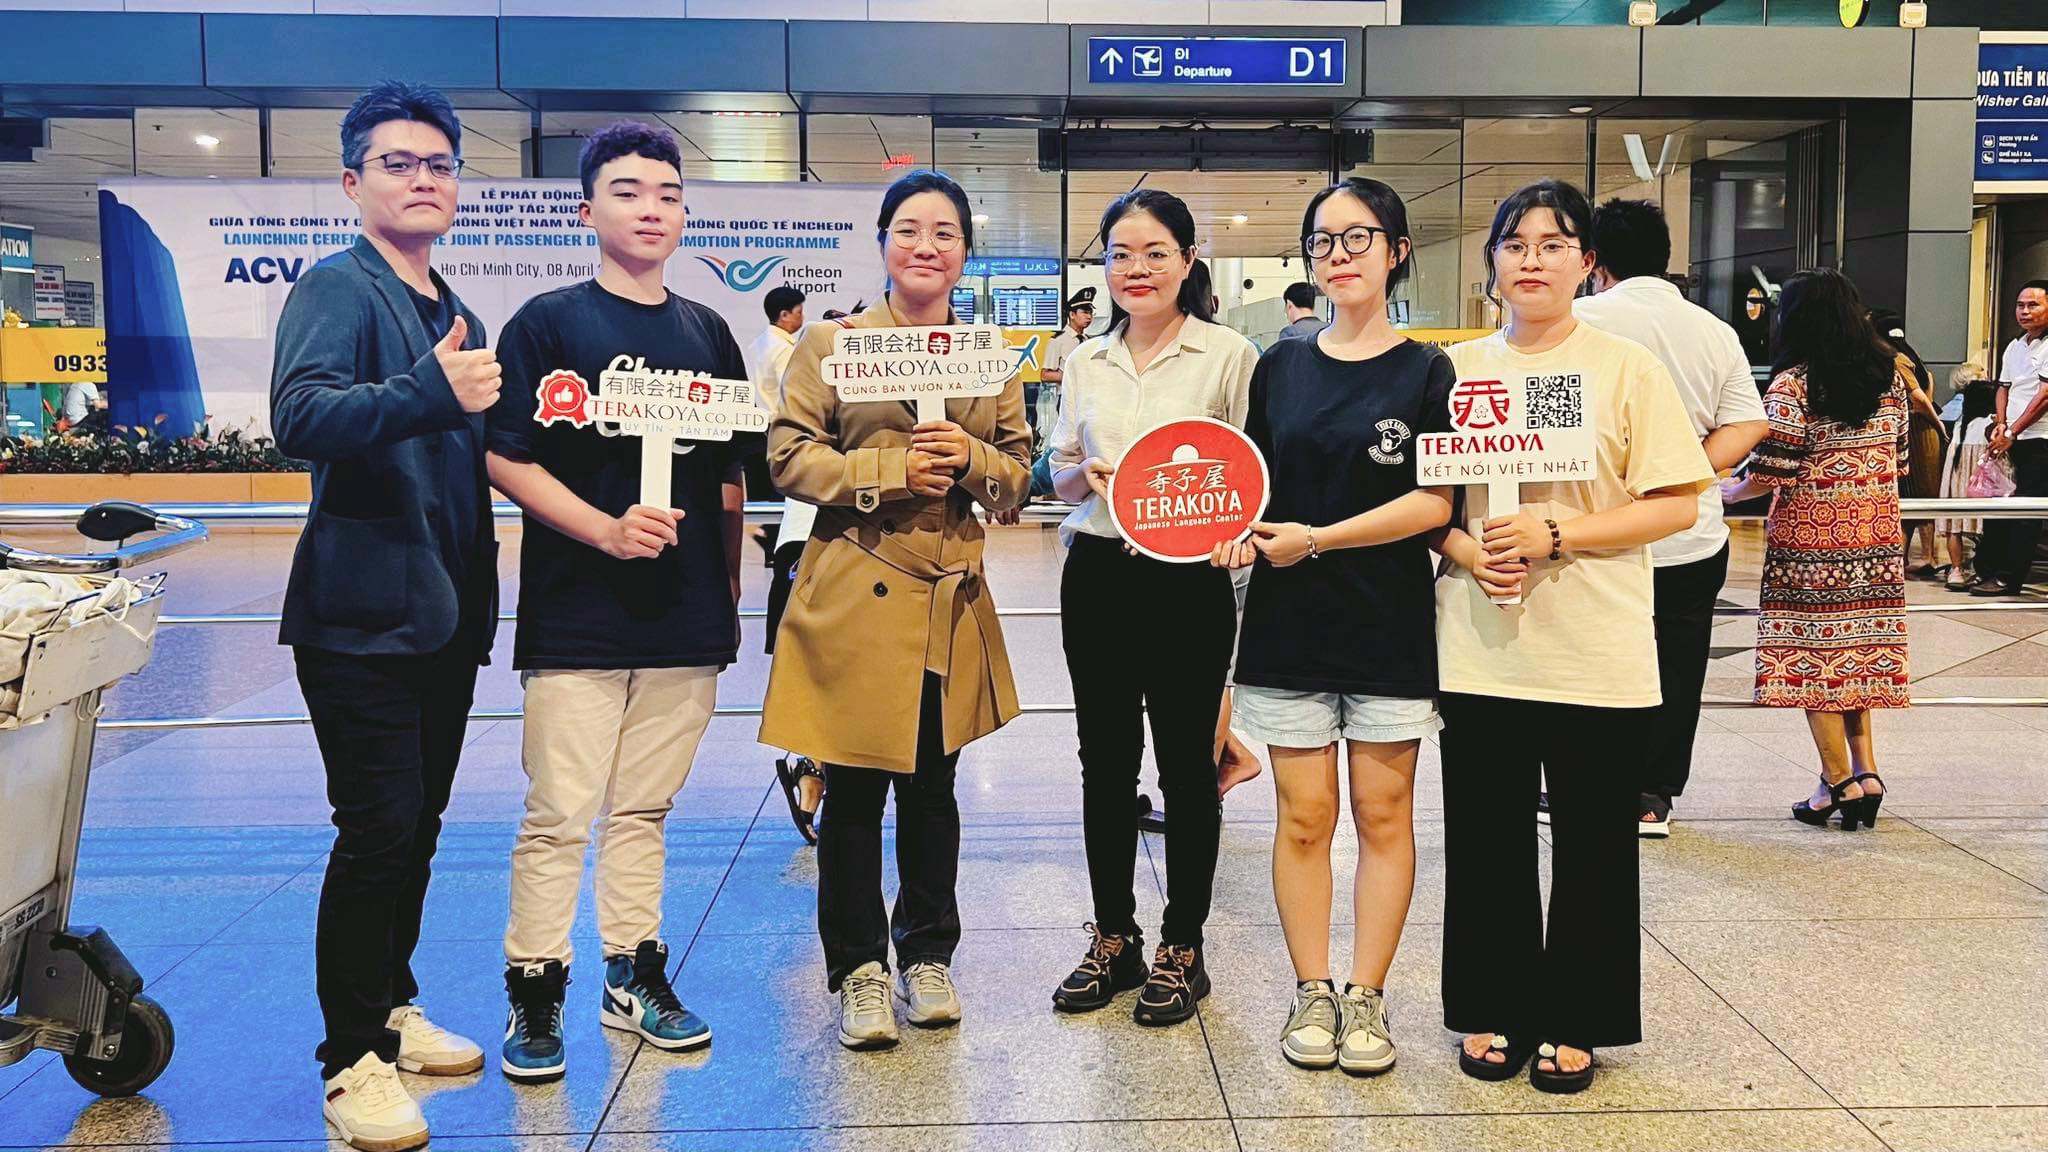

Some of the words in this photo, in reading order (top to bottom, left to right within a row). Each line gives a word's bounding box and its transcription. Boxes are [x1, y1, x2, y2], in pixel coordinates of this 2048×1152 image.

[1174, 47, 1189, 60] ĐI
[1289, 47, 1332, 77] D1
[1174, 65, 1232, 78] Departure
[1976, 69, 1999, 87] ƯA
[2003, 65, 2033, 87] TIỄN
[500, 188, 538, 200] PHÁT
[542, 189, 583, 202] ĐỘNG
[485, 203, 513, 215] HỢP
[519, 203, 545, 214] TÁC
[550, 203, 578, 214] XÚC
[209, 216, 244, 227] GIỮA
[290, 216, 329, 227] CÔNG
[334, 218, 349, 227] TY
[452, 217, 490, 227] HÔNG
[494, 217, 524, 228] VIỆT
[530, 218, 562, 228] NAM
[682, 218, 726, 229] HÔNG
[730, 218, 768, 231] QUỐC
[772, 217, 789, 230] TẾ
[792, 220, 853, 231] INCHEON
[224, 233, 308, 246] LAUNCHING
[450, 234, 490, 247] JOINT
[495, 233, 582, 247] PASSENGER
[744, 236, 840, 249] PROGRAMME
[224, 256, 304, 284] ACV
[441, 262, 457, 276] Ho
[460, 262, 479, 276] Chi
[483, 262, 512, 276] Minh
[516, 263, 543, 278] City,
[547, 263, 563, 276] 08
[567, 263, 594, 278] April
[782, 264, 842, 278] Incheon
[783, 280, 837, 296] Airport
[842, 330, 993, 355] 有限会社寺子屋
[828, 359, 943, 380] TERAKOYA
[605, 374, 750, 405] 有限会社寺子屋
[949, 381, 963, 391] XA
[592, 400, 701, 423] TERAKOYA
[624, 422, 639, 431] UY
[1422, 433, 1545, 456] TERAKOYA
[1423, 461, 1453, 478] KẾT
[1460, 461, 1491, 476] NỐI
[1499, 460, 1535, 477] VIỆT
[1543, 457, 1589, 476] NHẬT
[1145, 464, 1228, 494] 寺子屋
[1132, 489, 1243, 520] TERAKOYA
[1134, 521, 1170, 531] Japanese
[1174, 516, 1212, 527] Language
[1215, 513, 1243, 523] Center
